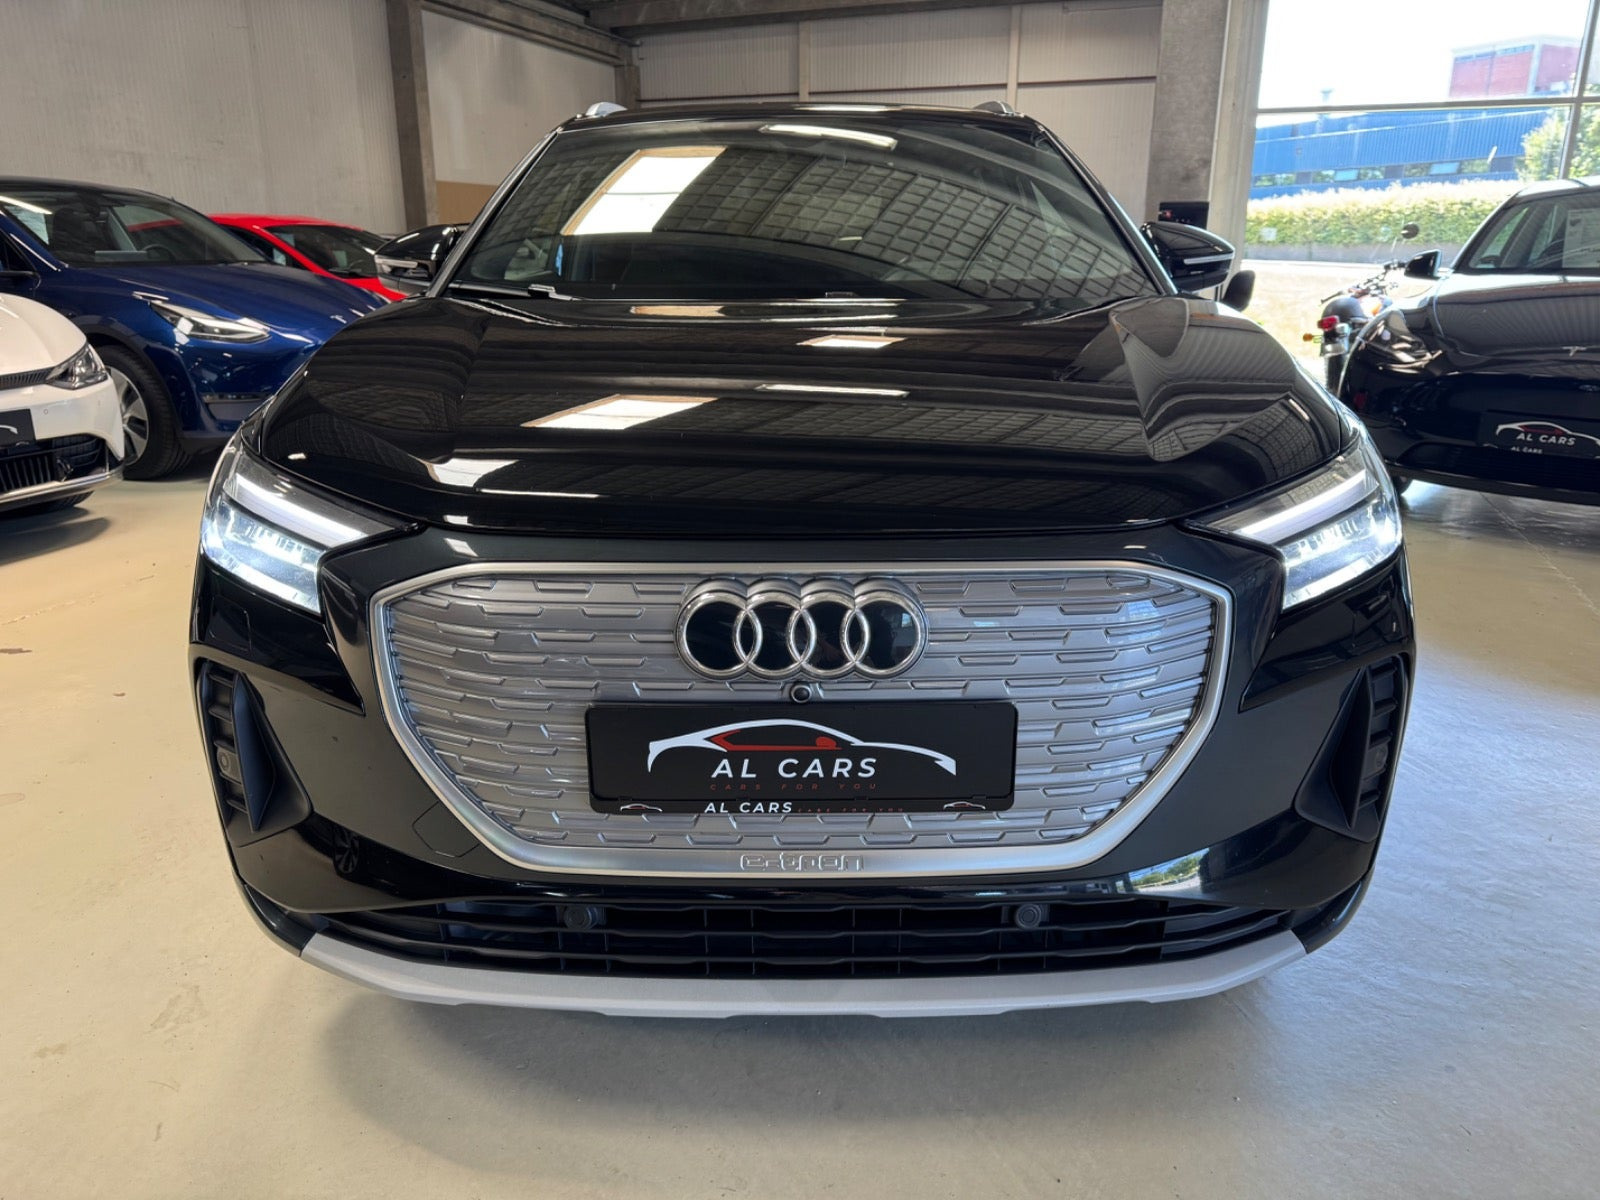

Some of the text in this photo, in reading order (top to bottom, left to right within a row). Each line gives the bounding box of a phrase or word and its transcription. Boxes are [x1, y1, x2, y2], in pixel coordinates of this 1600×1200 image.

[1516, 432, 1576, 446] AL CARS
[711, 758, 877, 779] AL CARS
[709, 783, 877, 791] CARS FOR YOU
[704, 802, 729, 813] AL
[739, 802, 793, 813] CARS
